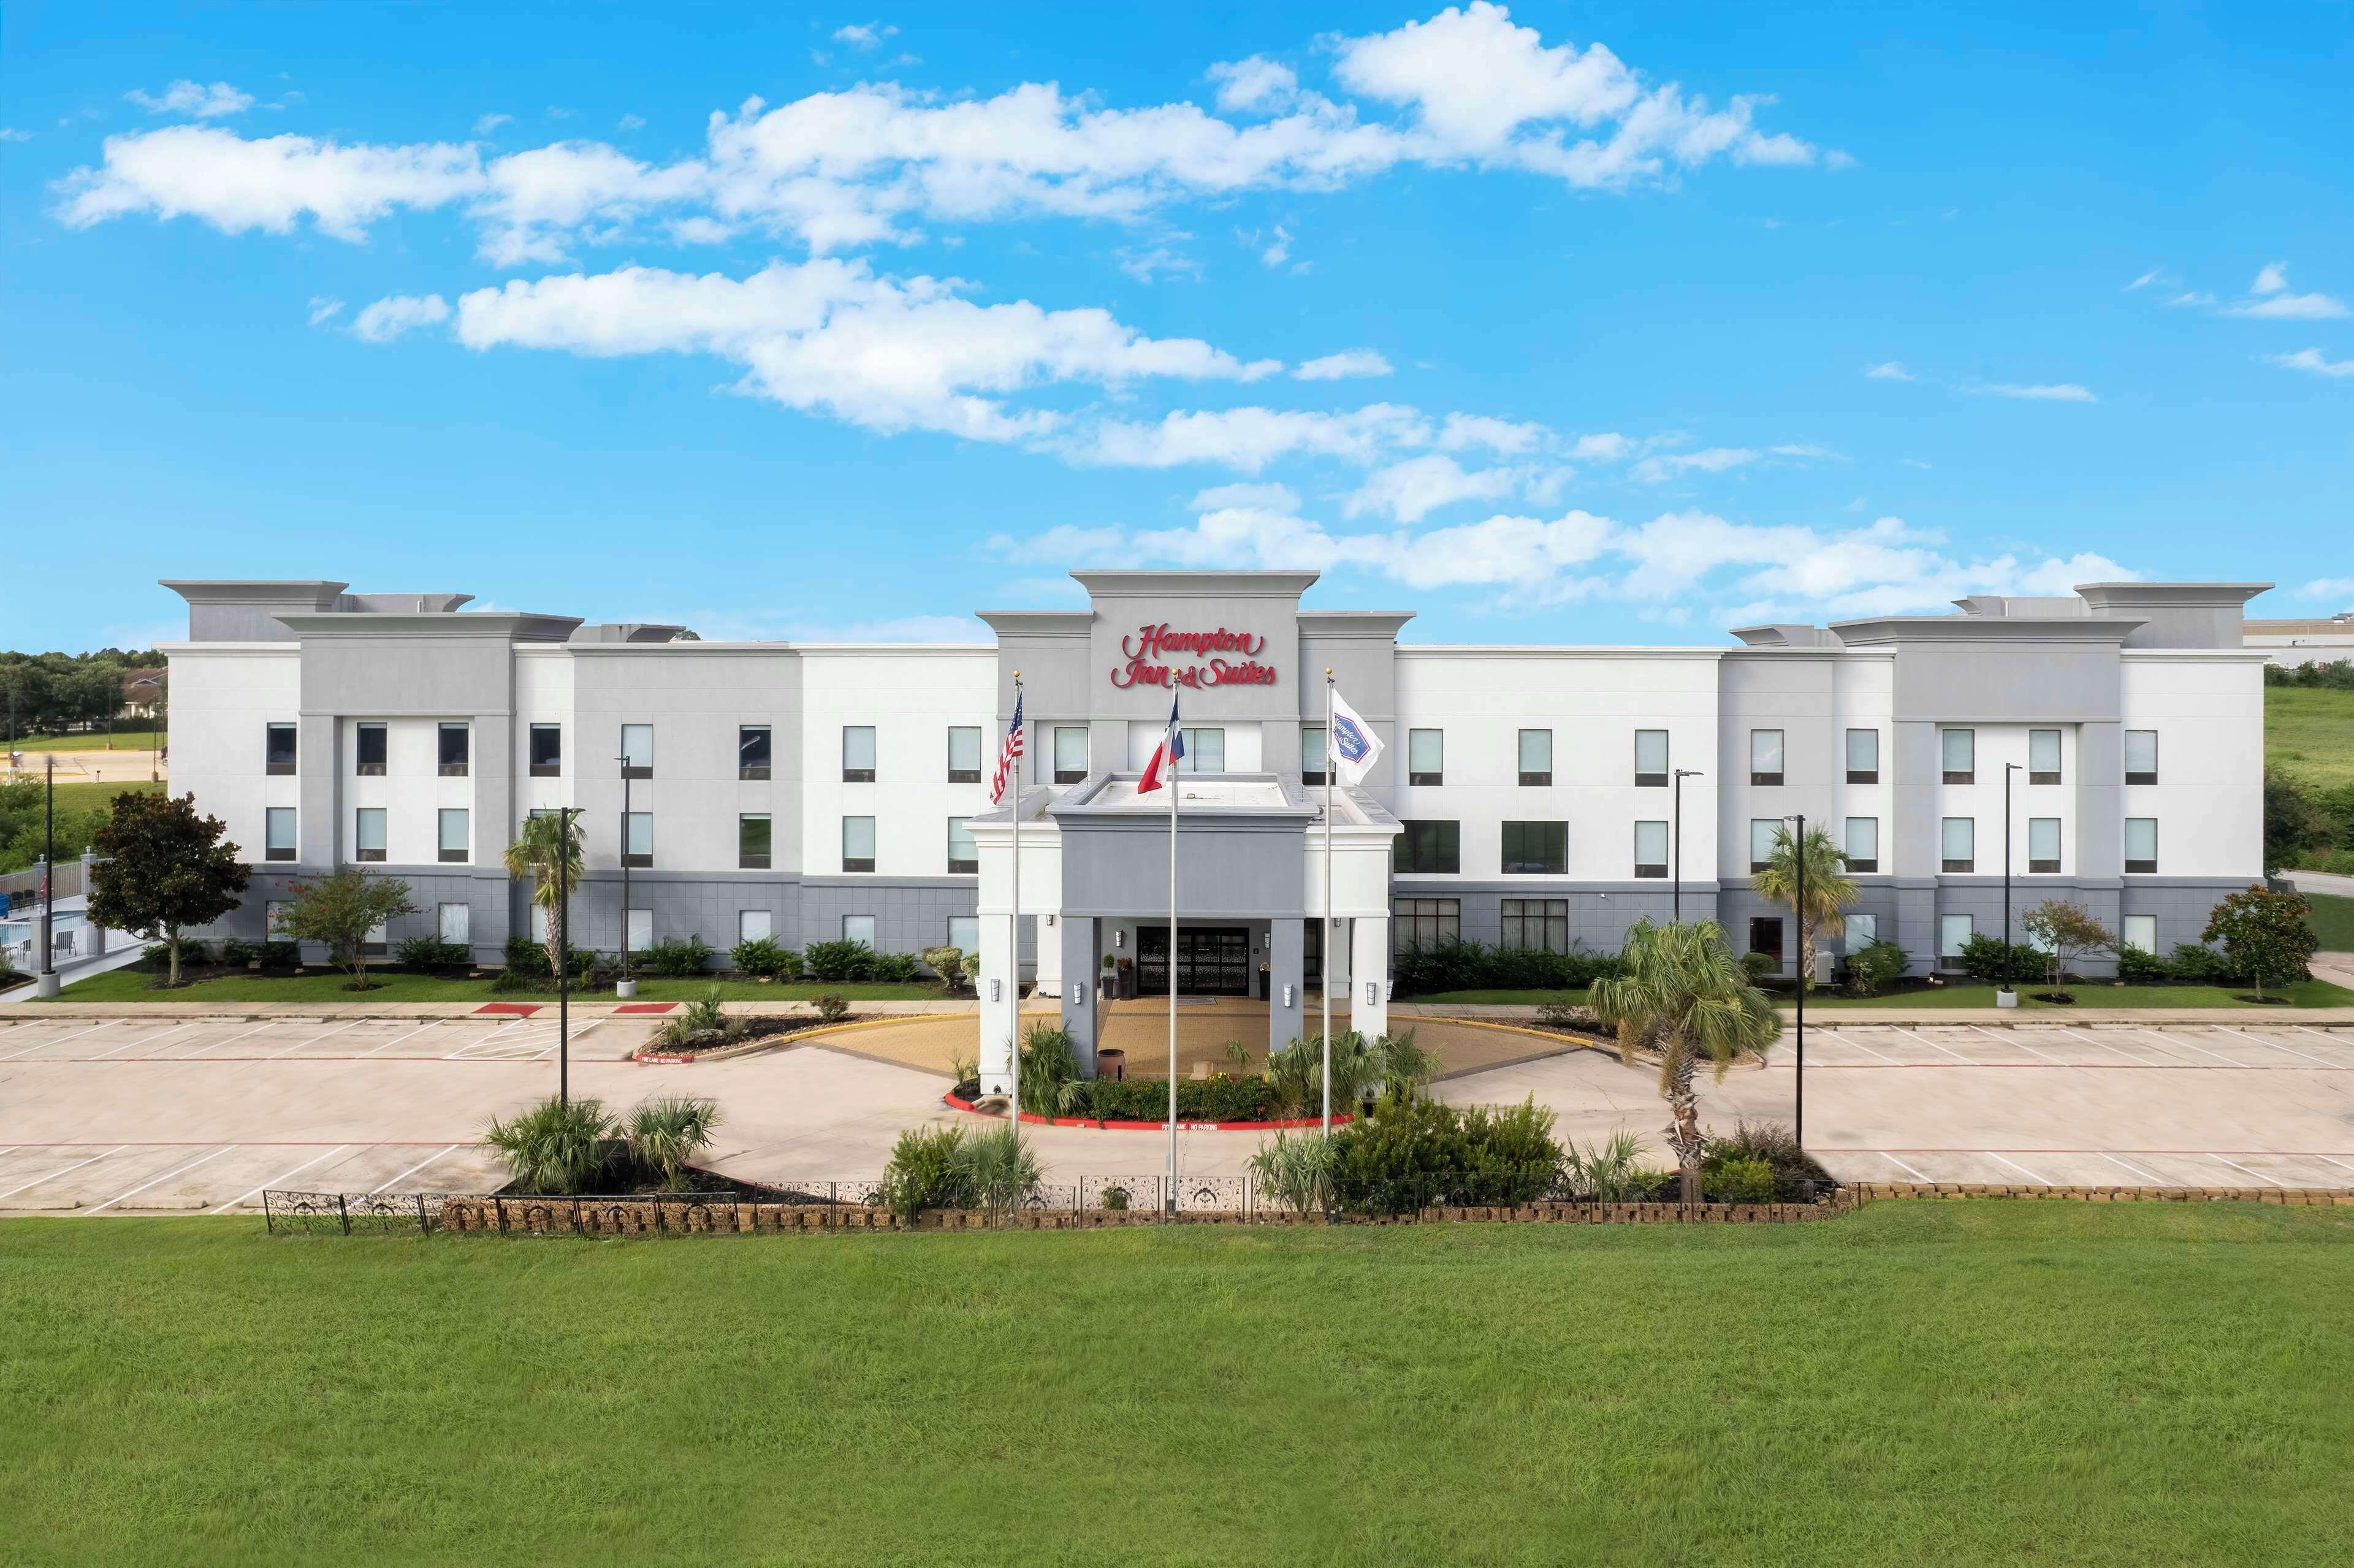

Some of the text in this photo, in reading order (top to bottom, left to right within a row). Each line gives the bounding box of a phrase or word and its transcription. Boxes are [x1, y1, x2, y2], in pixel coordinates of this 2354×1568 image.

[1122, 623, 1264, 660] Hampton
[1111, 658, 1276, 690] Inn & Suites
[1341, 737, 1358, 755] Suites
